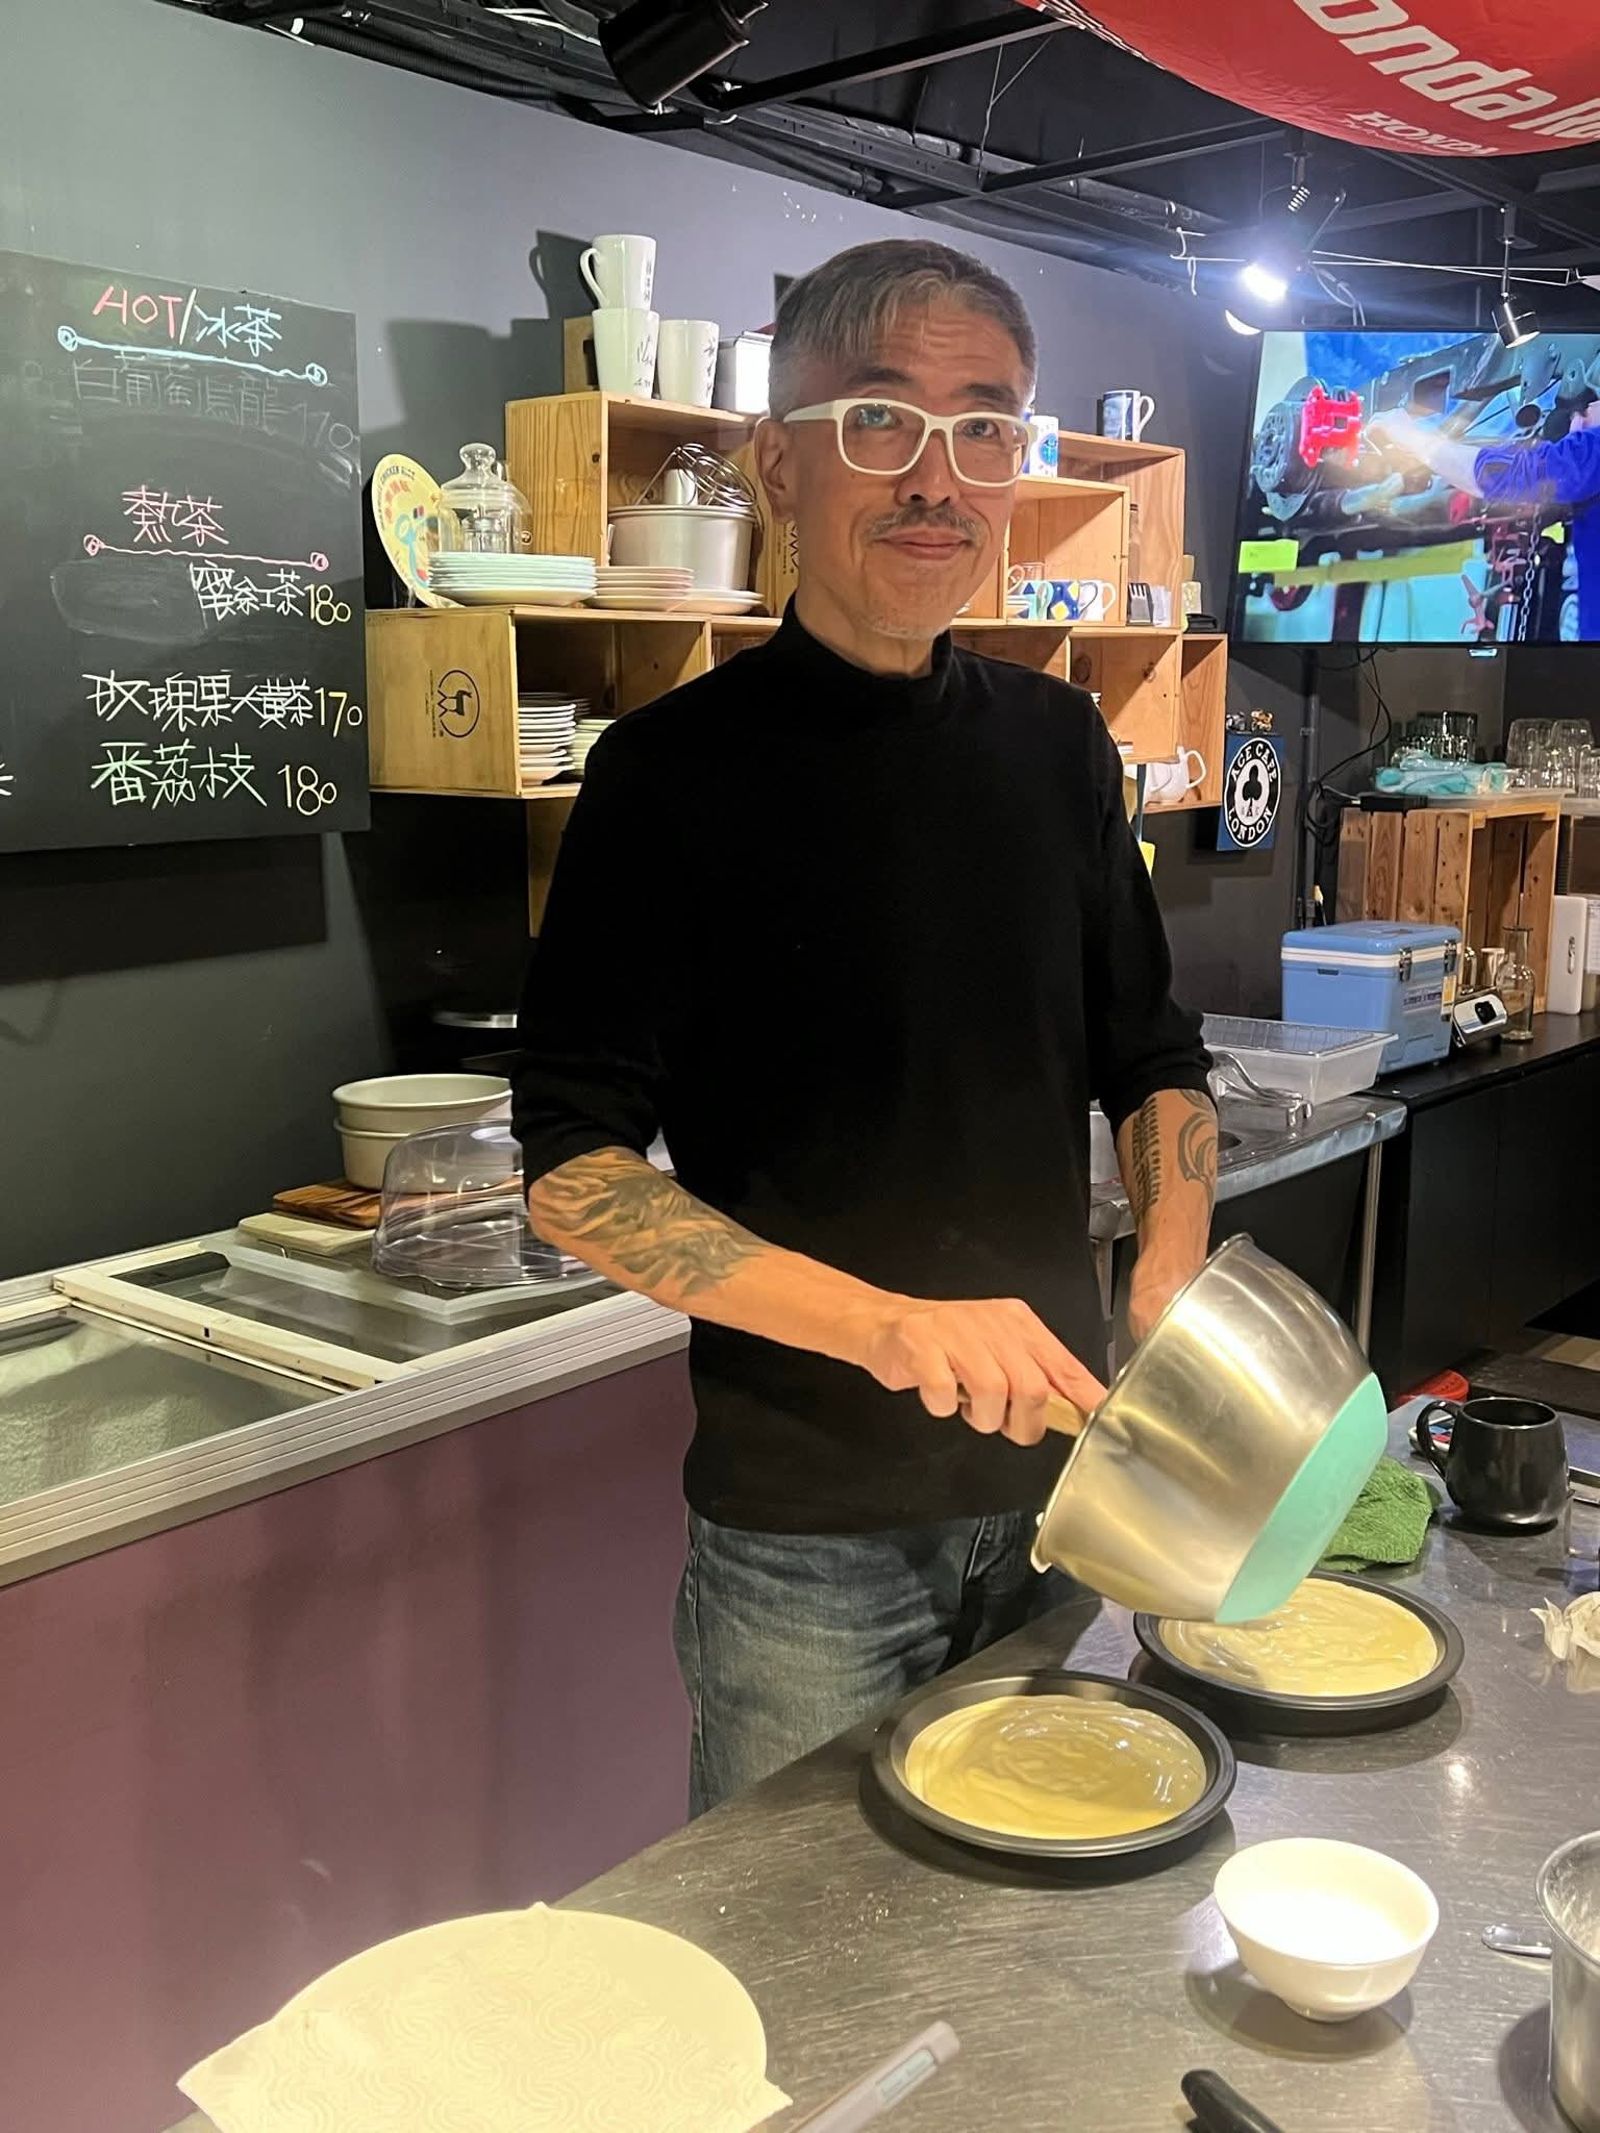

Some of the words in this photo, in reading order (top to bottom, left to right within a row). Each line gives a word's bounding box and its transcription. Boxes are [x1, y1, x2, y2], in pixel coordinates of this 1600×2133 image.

[121, 485, 229, 547] 熱茶
[304, 584, 351, 625] 180
[314, 687, 363, 738] 170
[91, 738, 267, 810] 番荔枝
[277, 764, 337, 815] 180
[1231, 746, 1252, 781] ACE
[1228, 806, 1272, 841] LONDON
